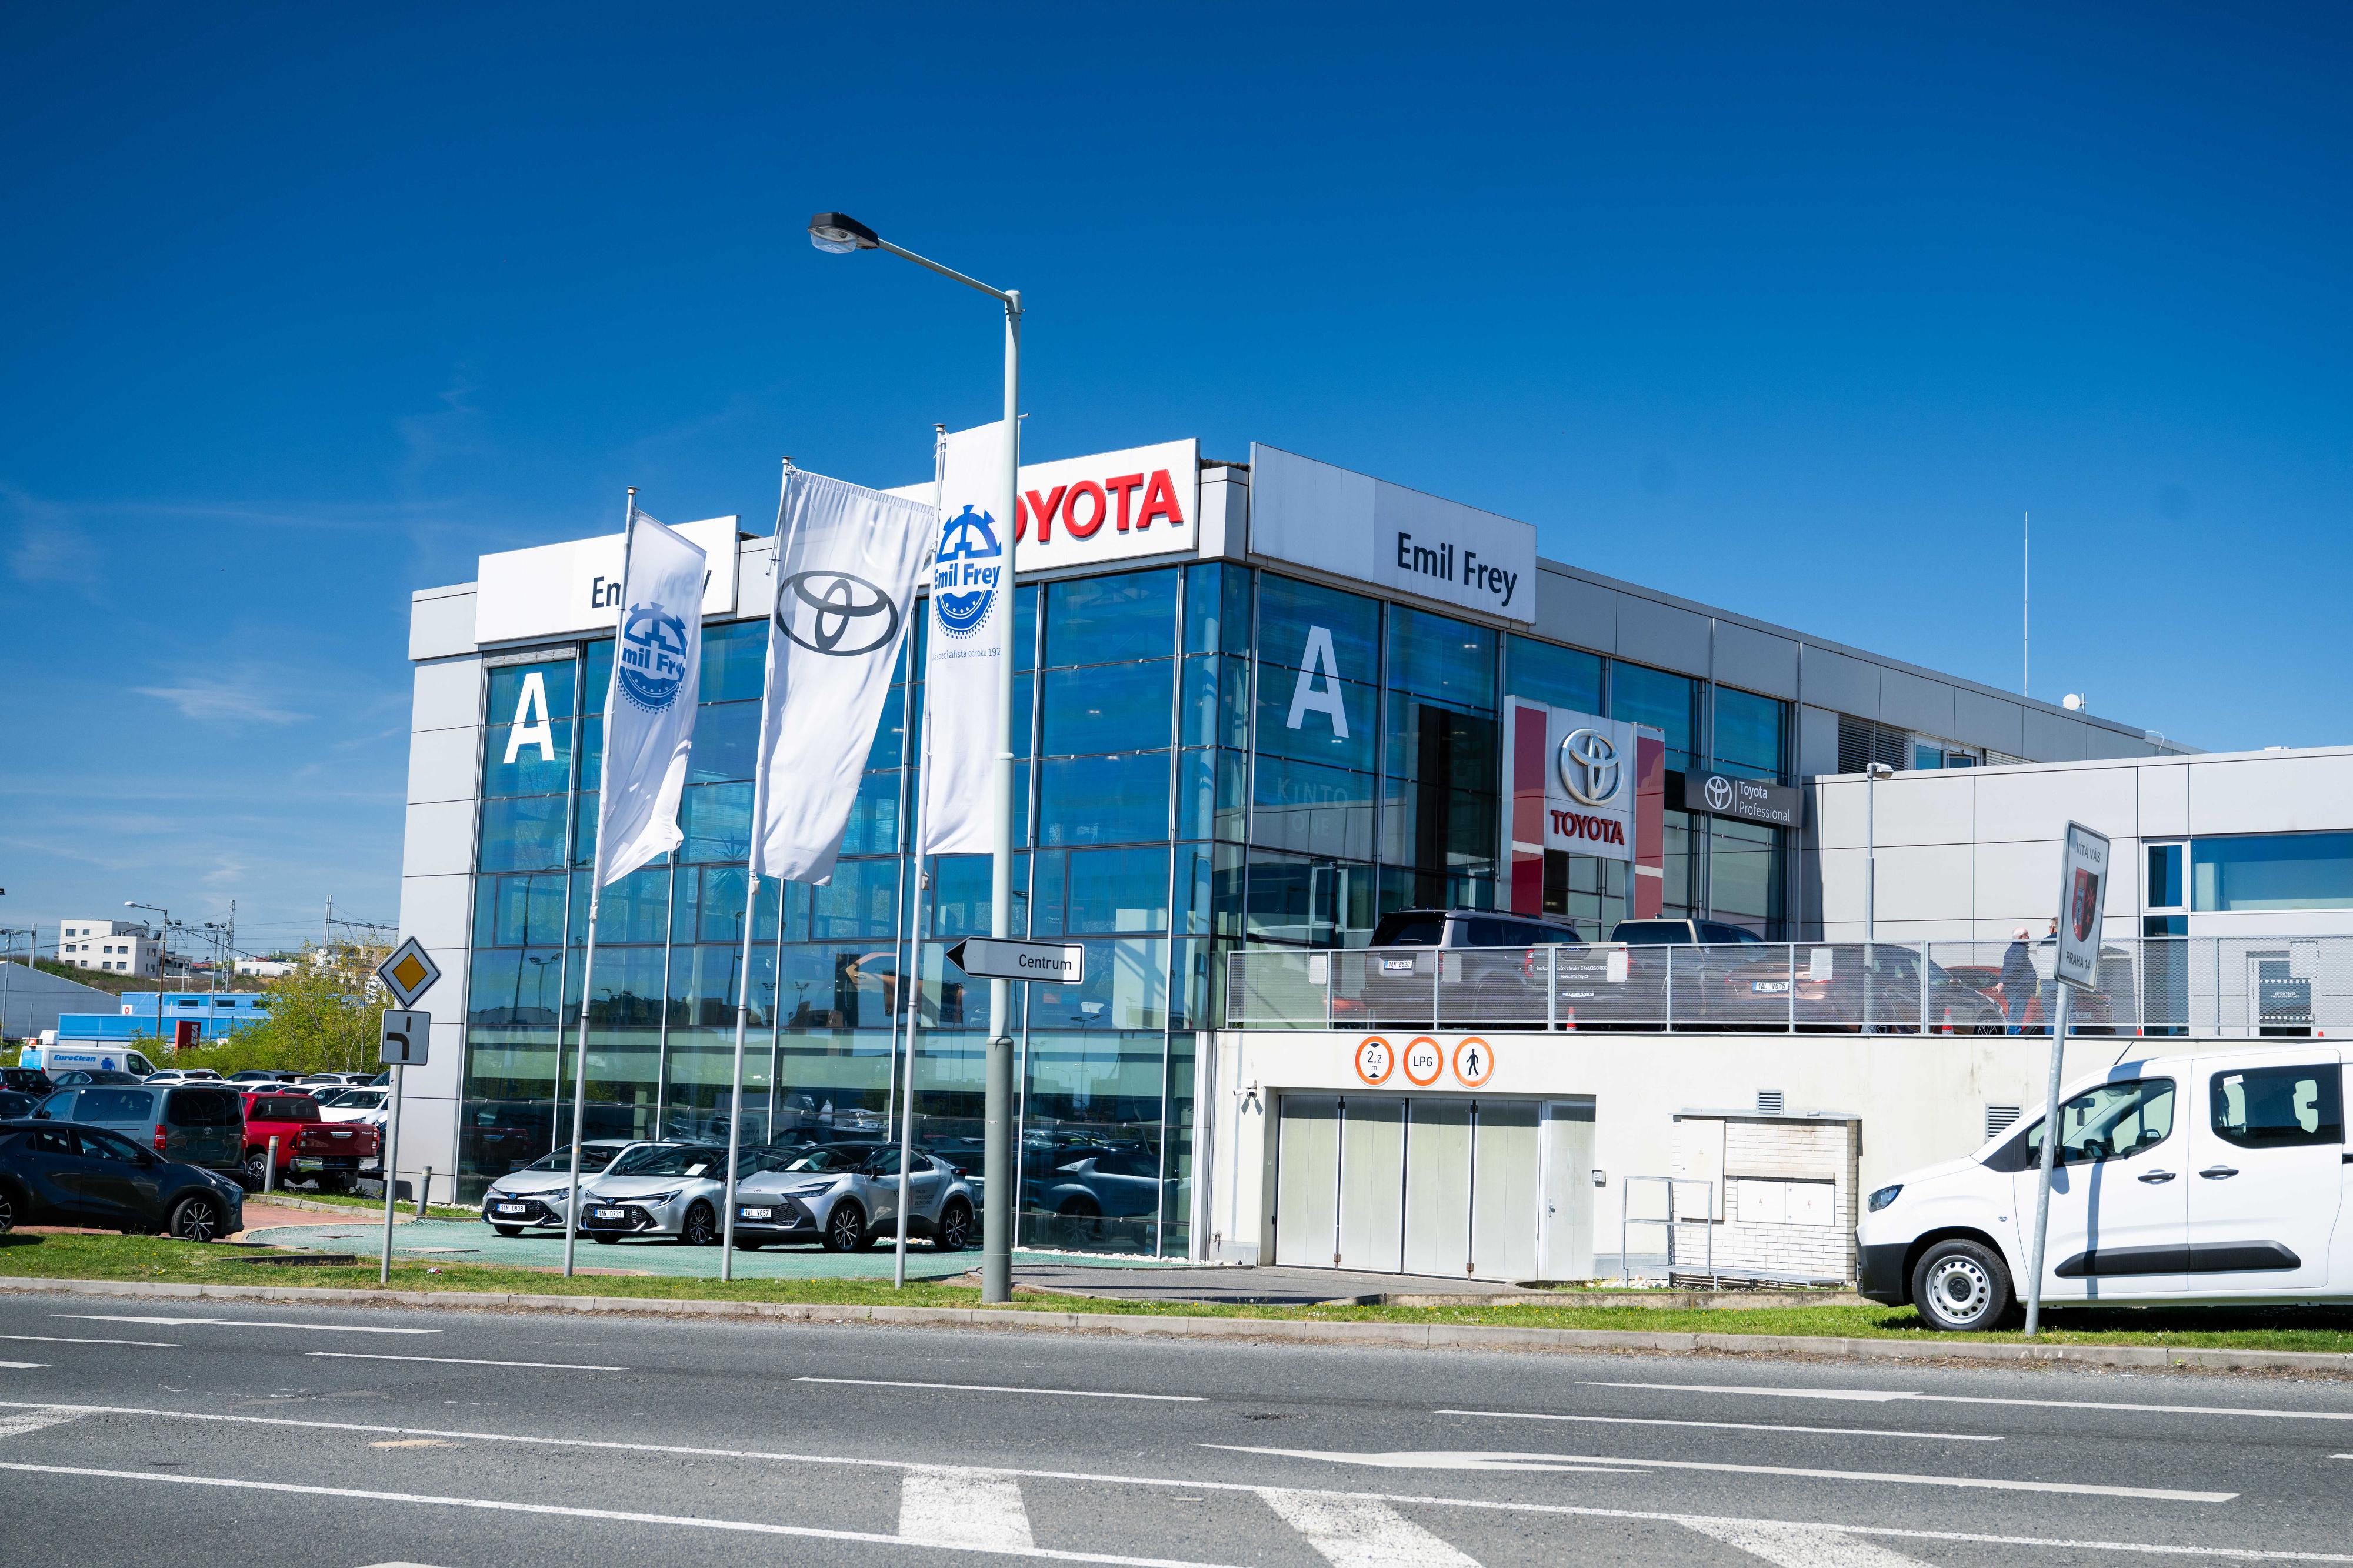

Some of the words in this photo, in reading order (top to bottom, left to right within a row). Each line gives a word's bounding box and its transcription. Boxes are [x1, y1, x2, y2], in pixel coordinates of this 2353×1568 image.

[1016, 469, 1184, 543] YOTA
[964, 563, 1001, 589] Frey
[1398, 532, 1453, 581] Emil
[1464, 551, 1518, 607] Frey
[592, 576, 621, 608] Em
[622, 647, 651, 669] mil
[976, 648, 987, 657] roku
[988, 647, 1001, 656] 192
[1286, 625, 1349, 738] A
[503, 672, 555, 763] A
[1739, 781, 1768, 799] Toyota
[1739, 801, 1790, 822] Professional
[1551, 809, 1624, 845] TOYOTA
[2077, 841, 2088, 859] VÍTÁ
[2089, 848, 2101, 863] VÁS
[1019, 954, 1072, 970] Centrum
[2066, 951, 2084, 968] PRAHA
[2085, 958, 2091, 970] 14
[54, 1054, 96, 1062] EuroClean
[1368, 1050, 1382, 1063] 2,2
[1413, 1056, 1433, 1067] LPG
